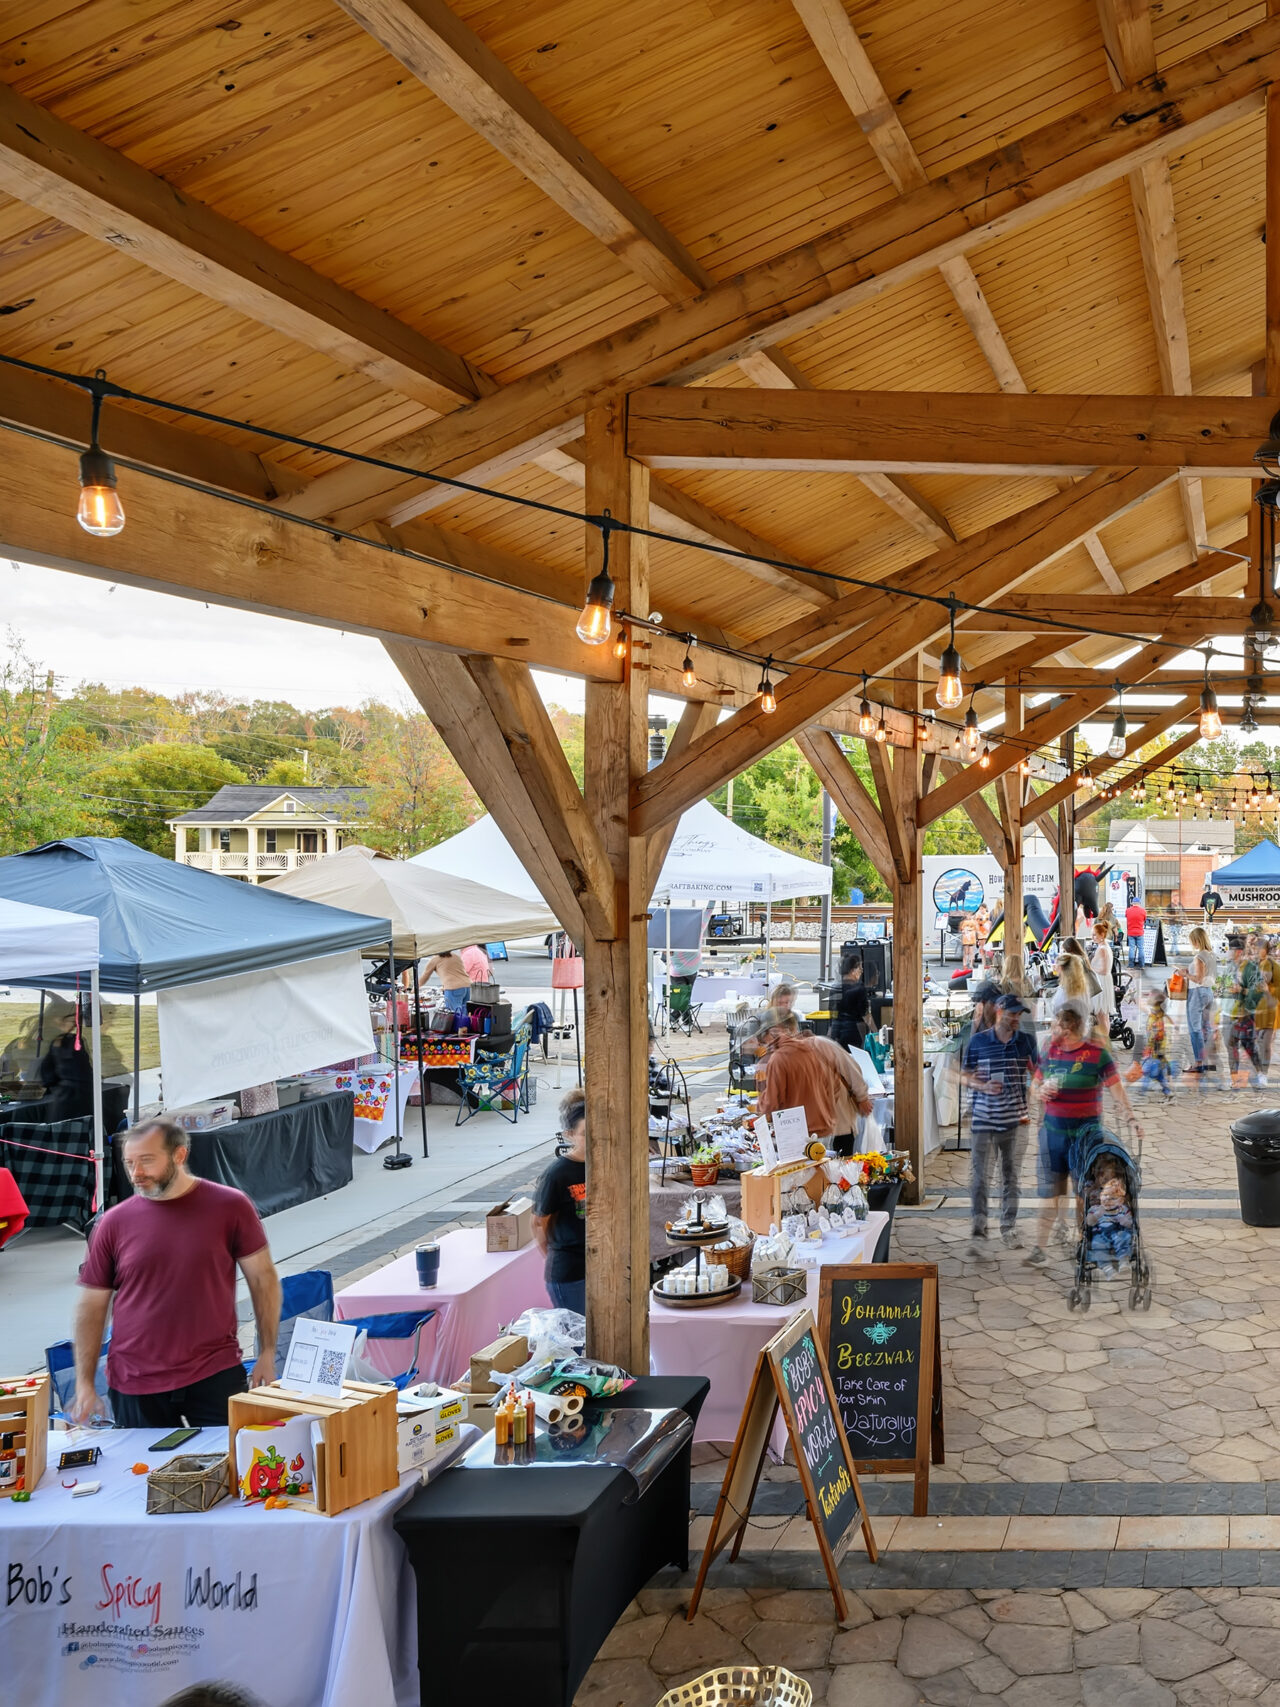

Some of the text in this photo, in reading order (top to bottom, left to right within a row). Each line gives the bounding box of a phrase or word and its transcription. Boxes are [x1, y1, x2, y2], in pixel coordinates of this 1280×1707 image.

[670, 883, 733, 892] RAFTBAKING.COM
[837, 1376, 907, 1391] Take Care of
[440, 1407, 461, 1419] GLOVES
[5, 1562, 259, 1625] Bob's Spicy World
[59, 1621, 205, 1640] Handcrafted Sauces
